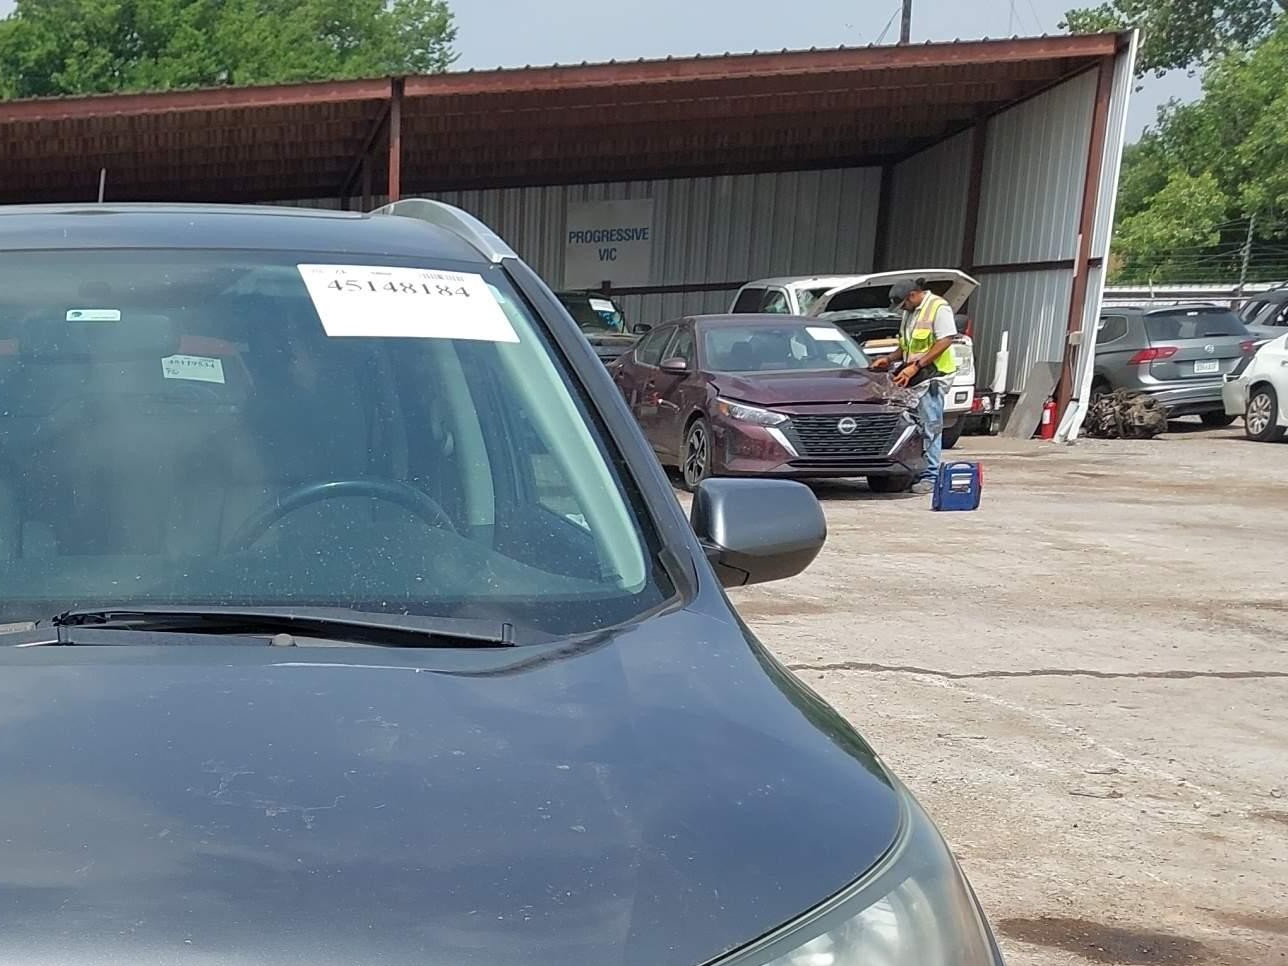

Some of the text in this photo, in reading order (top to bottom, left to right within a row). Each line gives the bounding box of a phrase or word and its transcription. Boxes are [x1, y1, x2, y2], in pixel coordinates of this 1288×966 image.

[568, 227, 649, 244] PROGRESSIVE
[598, 247, 617, 262] VIC
[327, 279, 471, 298] 45148184
